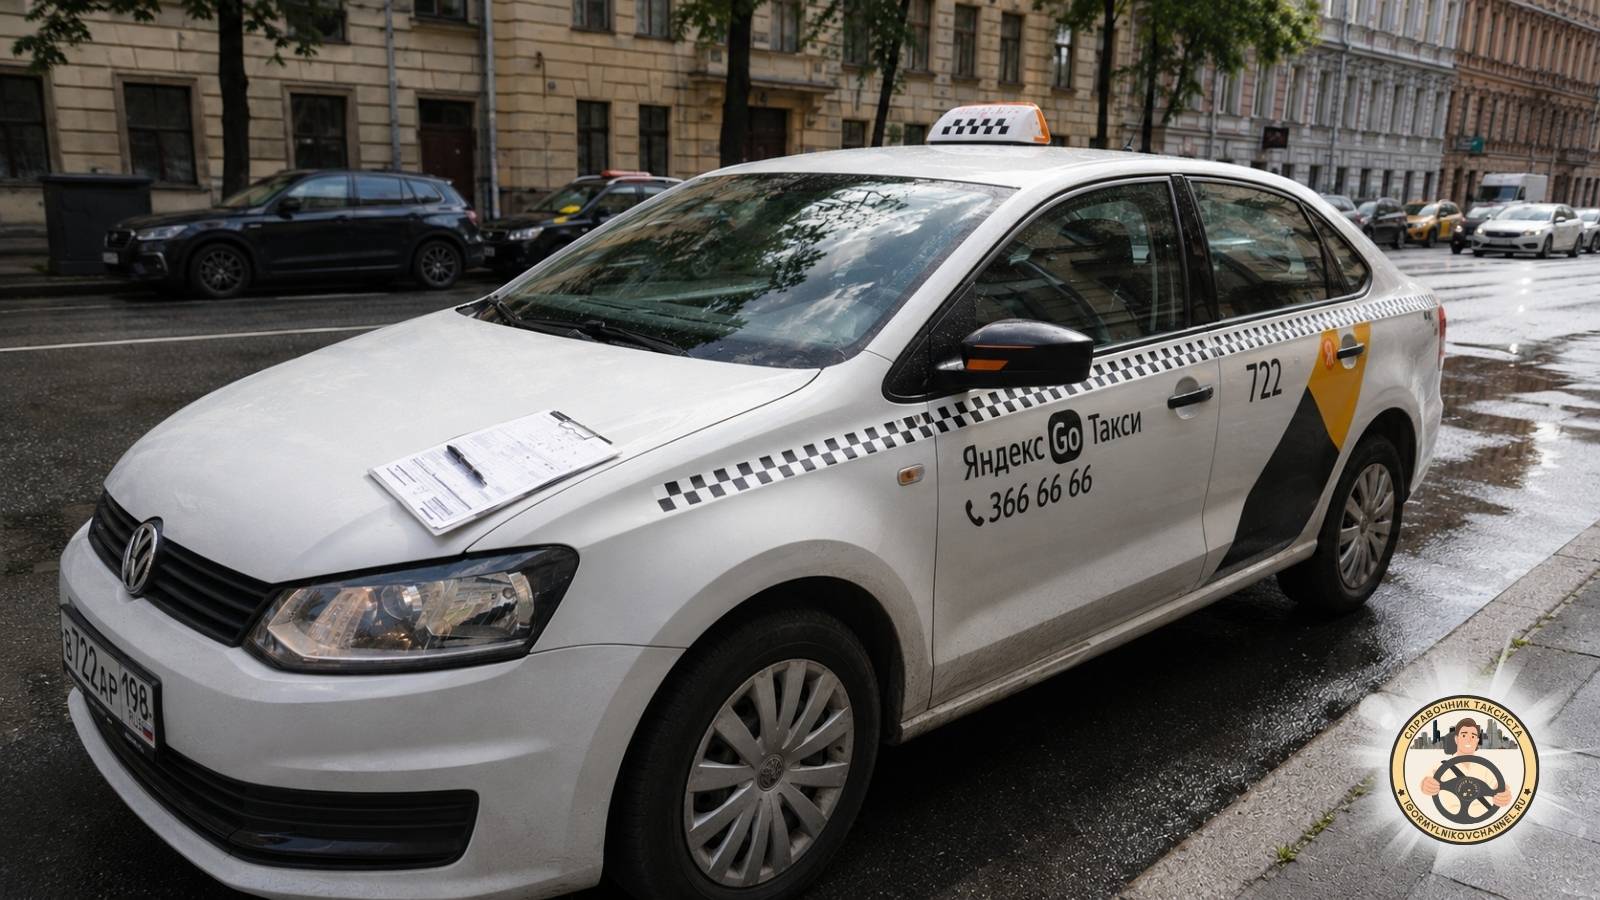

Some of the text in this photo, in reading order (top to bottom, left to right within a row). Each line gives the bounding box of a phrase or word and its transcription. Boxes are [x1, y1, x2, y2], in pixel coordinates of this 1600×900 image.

[1246, 358, 1282, 403] 722
[963, 411, 1142, 481] Яндекс Go Такси
[989, 464, 1093, 523] 366 66 66
[121, 671, 149, 721] 198
